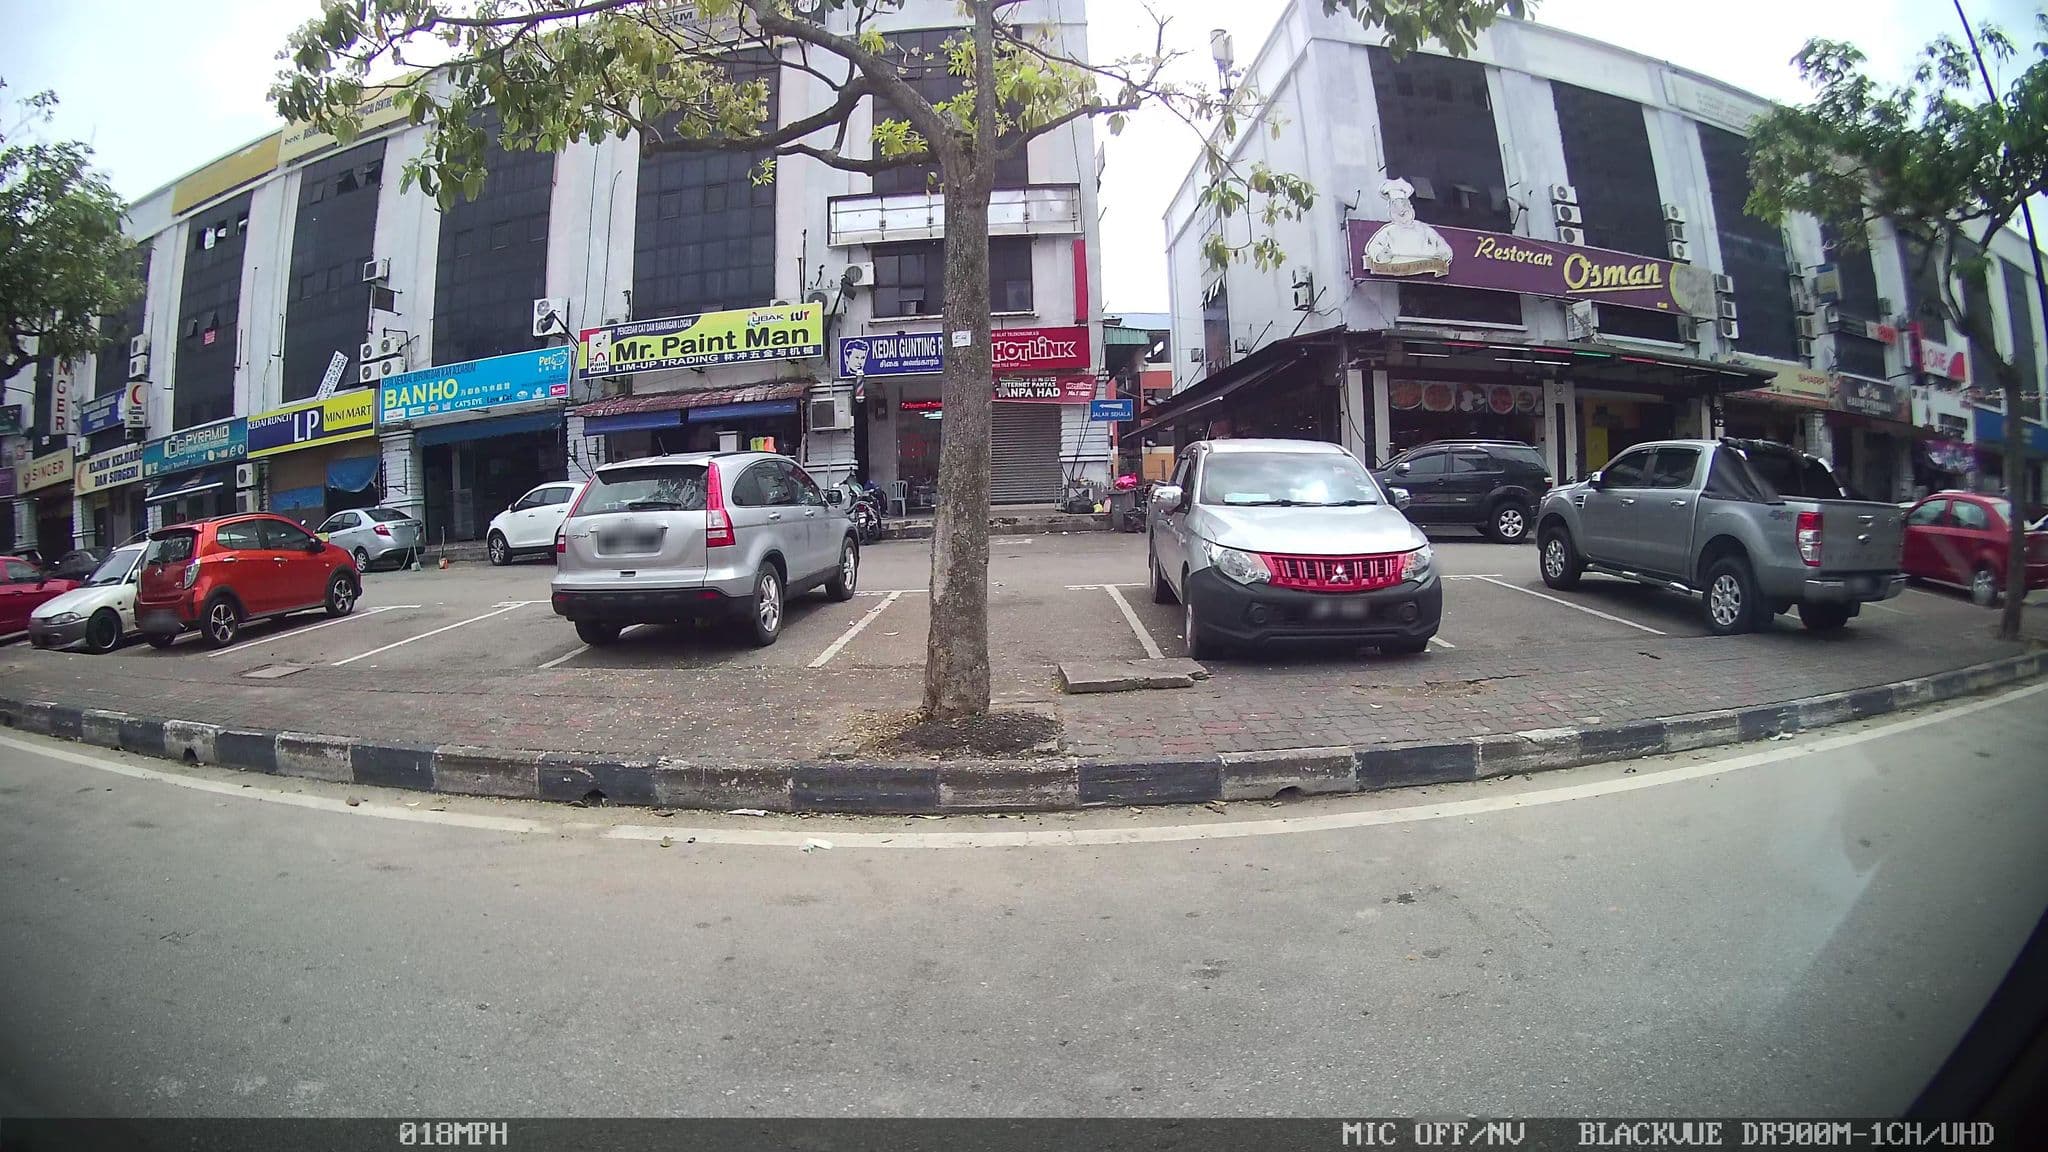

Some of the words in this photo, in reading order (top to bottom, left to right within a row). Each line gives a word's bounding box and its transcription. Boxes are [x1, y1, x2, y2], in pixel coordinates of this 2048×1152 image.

[1474, 236, 1553, 266] Restoran
[1563, 252, 1662, 290] Osman
[616, 341, 655, 362] Mr.
[662, 330, 738, 357] Paint
[745, 326, 809, 348] Man
[872, 339, 897, 359] KEDAI
[899, 337, 936, 358] GUNTING
[615, 360, 657, 372] LIM-UP
[660, 354, 720, 368] TRADING
[384, 379, 458, 409] BANHO
[1036, 387, 1061, 398] HAD
[325, 410, 344, 423] MINI
[345, 404, 372, 418] MART
[186, 425, 230, 446] PYRAMID
[293, 409, 320, 443] LP
